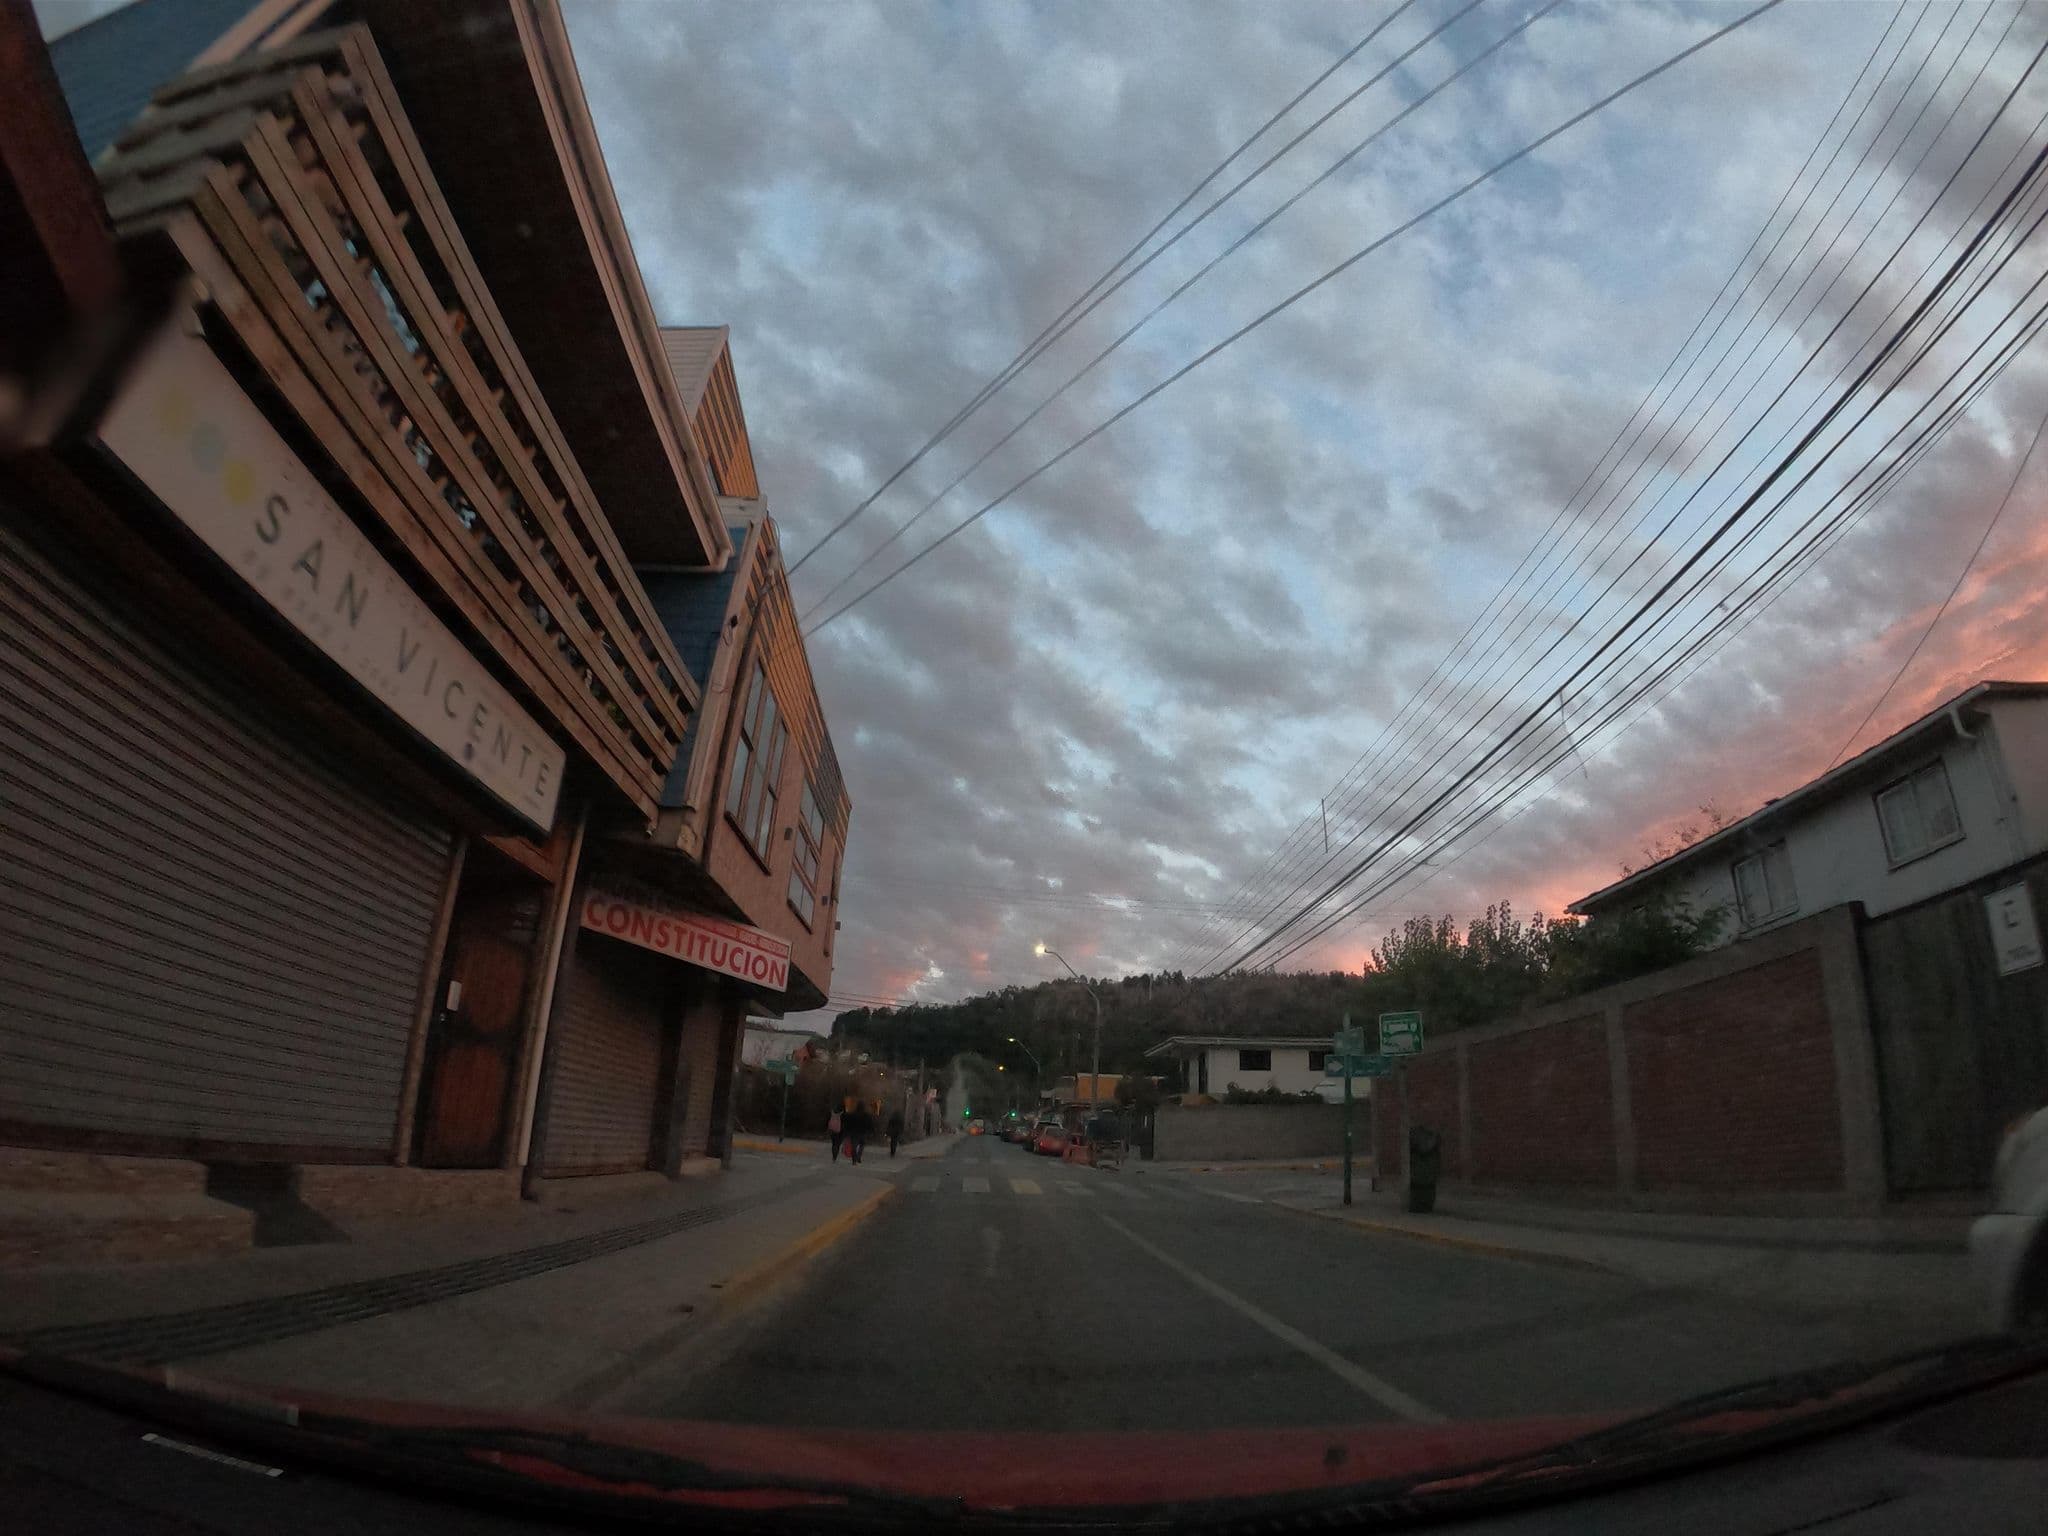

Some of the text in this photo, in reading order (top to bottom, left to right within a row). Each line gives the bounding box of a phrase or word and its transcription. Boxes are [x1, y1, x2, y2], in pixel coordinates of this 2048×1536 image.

[254, 493, 369, 629] SAN
[396, 626, 551, 798] VICENTE
[586, 899, 787, 988] CONSTITUCION
